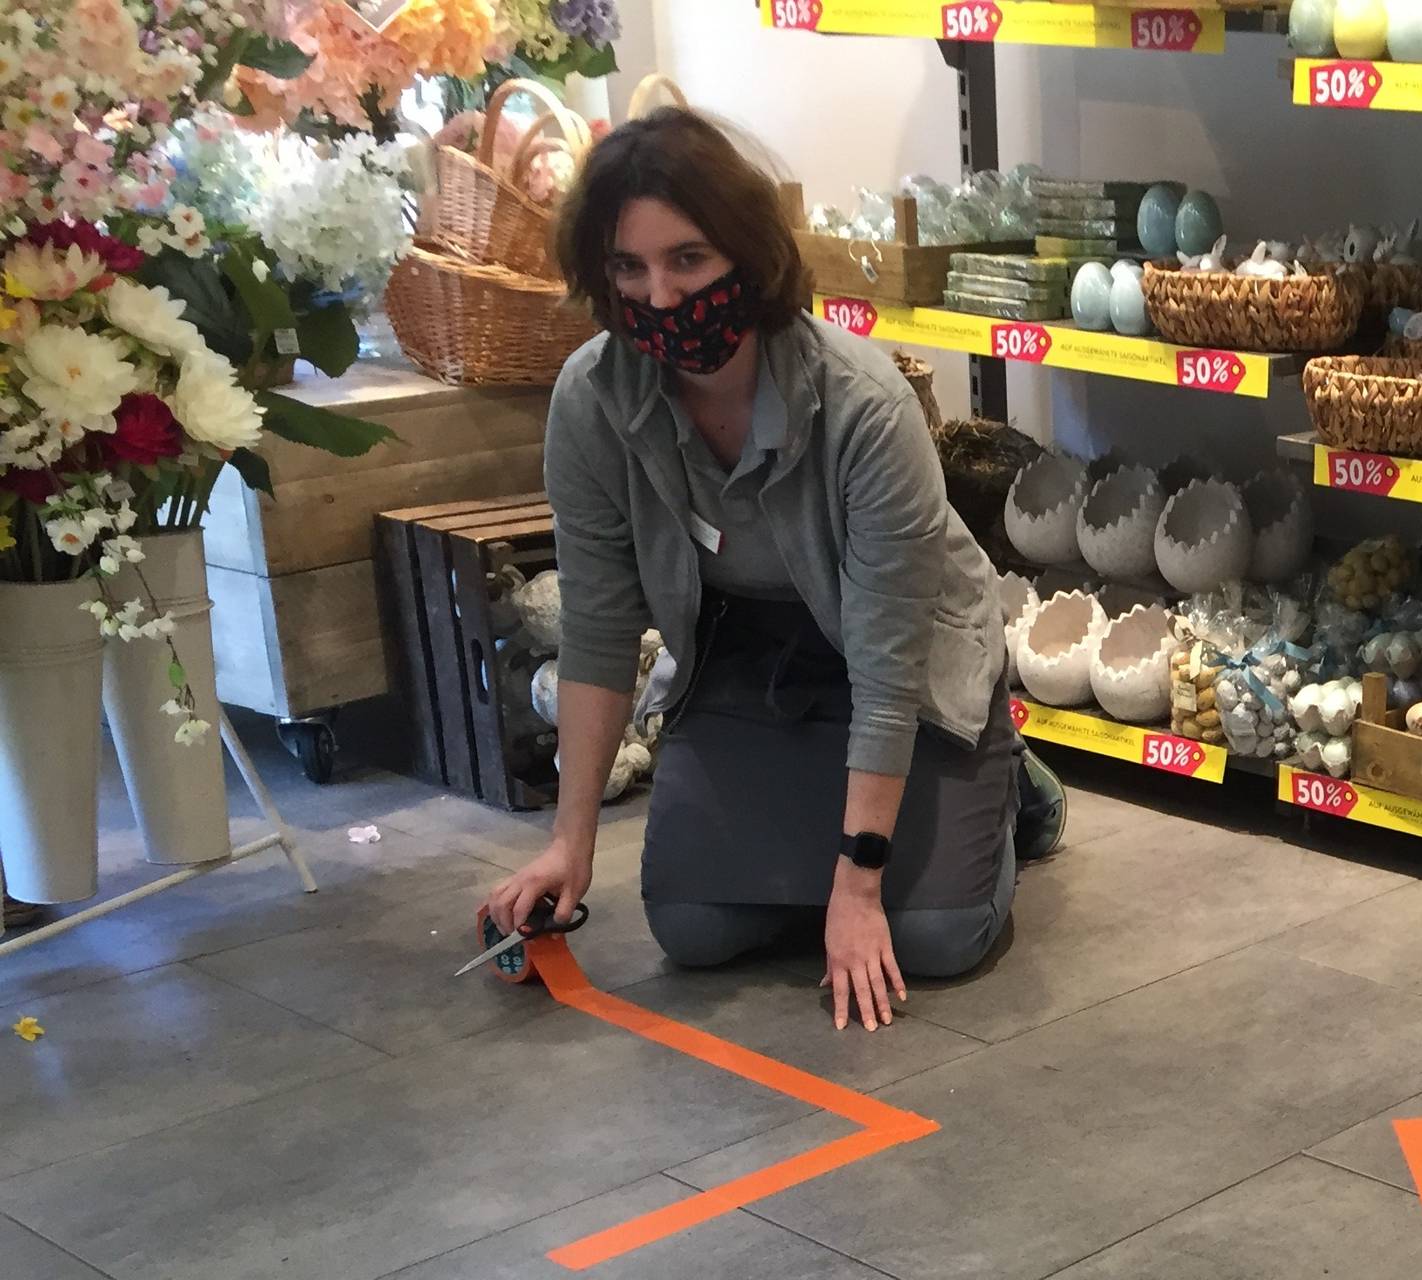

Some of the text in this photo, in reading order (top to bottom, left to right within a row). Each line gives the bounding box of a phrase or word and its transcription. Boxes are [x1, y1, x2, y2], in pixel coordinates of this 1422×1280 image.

[775, 0, 811, 27] 50%
[946, 6, 989, 38] 50%
[1136, 15, 1185, 47] 50%
[1316, 69, 1366, 104] 50%
[828, 303, 866, 330] 50%
[996, 329, 1038, 358] 50%
[1182, 356, 1229, 386] 50%
[1335, 458, 1382, 486] 50%
[1146, 740, 1191, 767] 50%
[1297, 778, 1343, 809] 50%
